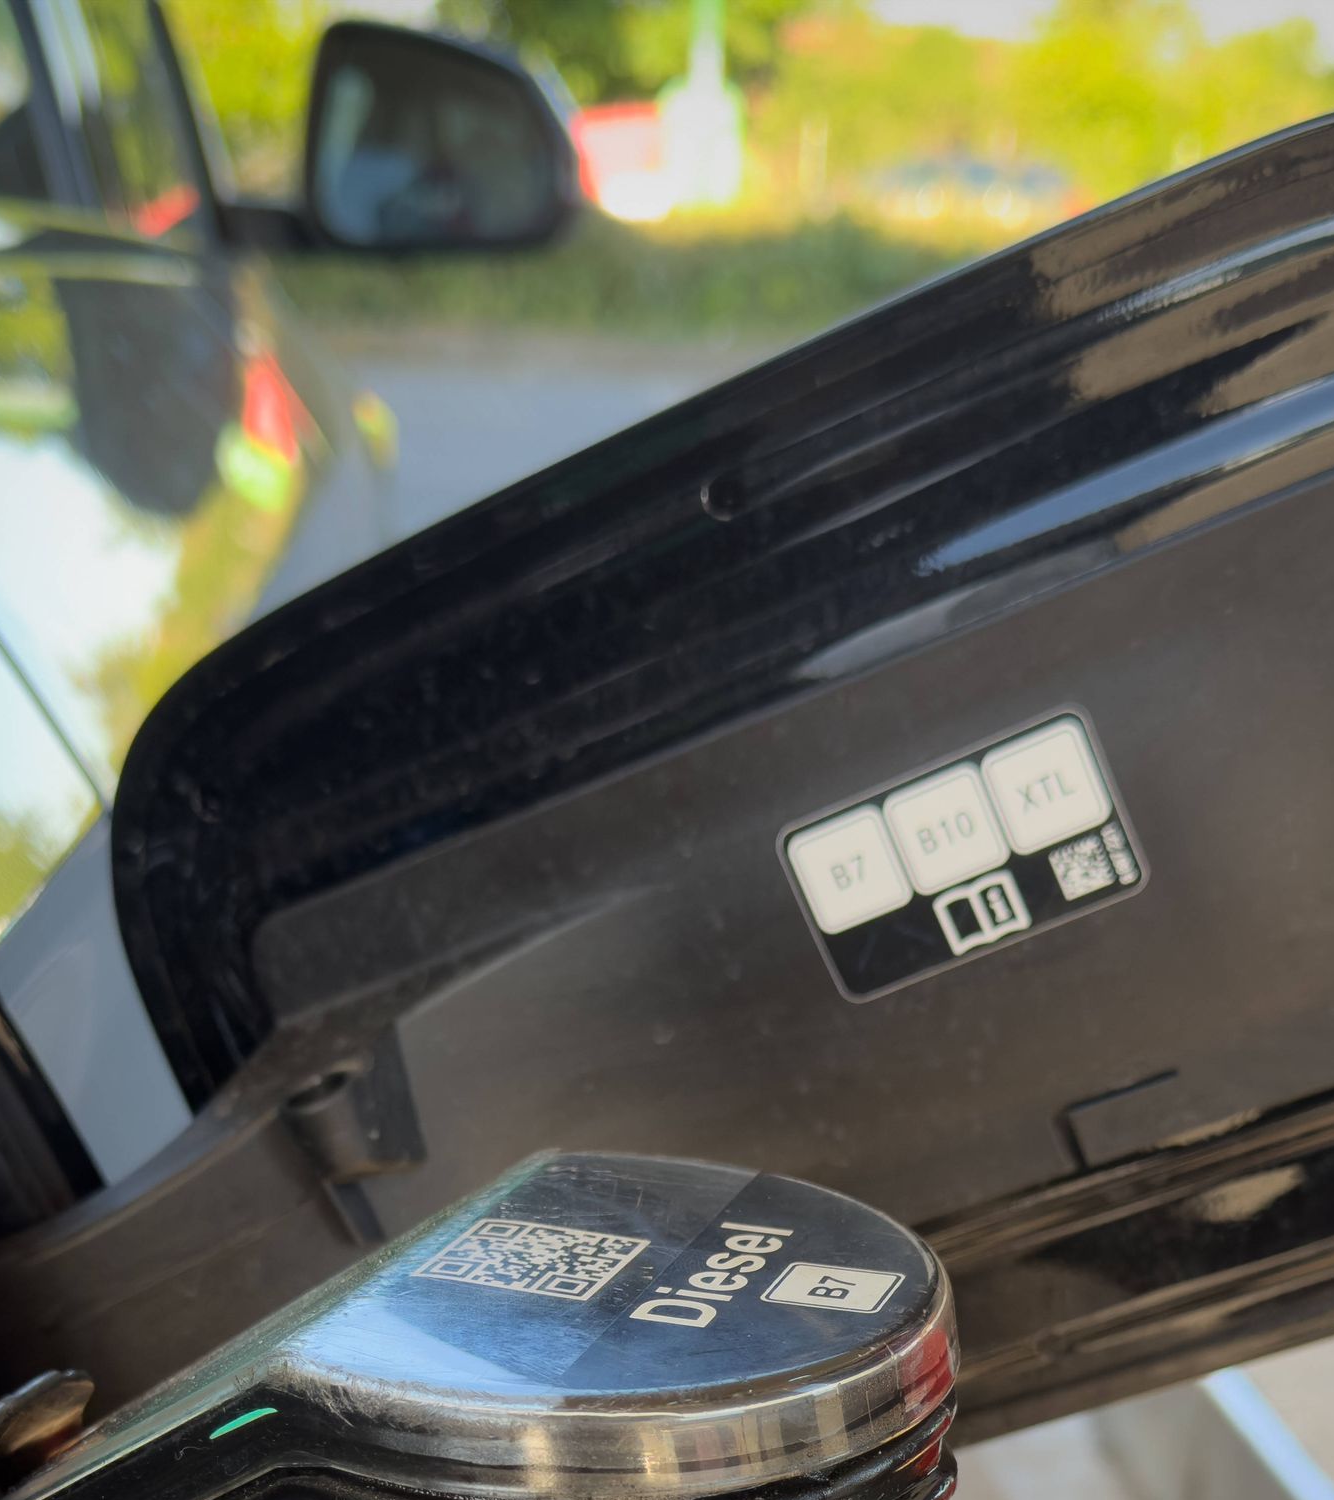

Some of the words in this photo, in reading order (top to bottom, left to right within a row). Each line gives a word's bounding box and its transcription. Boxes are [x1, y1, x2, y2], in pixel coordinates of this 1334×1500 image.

[829, 854, 870, 893] B7
[916, 811, 977, 856] B10
[1016, 768, 1078, 815] XTL
[629, 1221, 795, 1329] Diesel
[810, 1273, 861, 1301] B7
